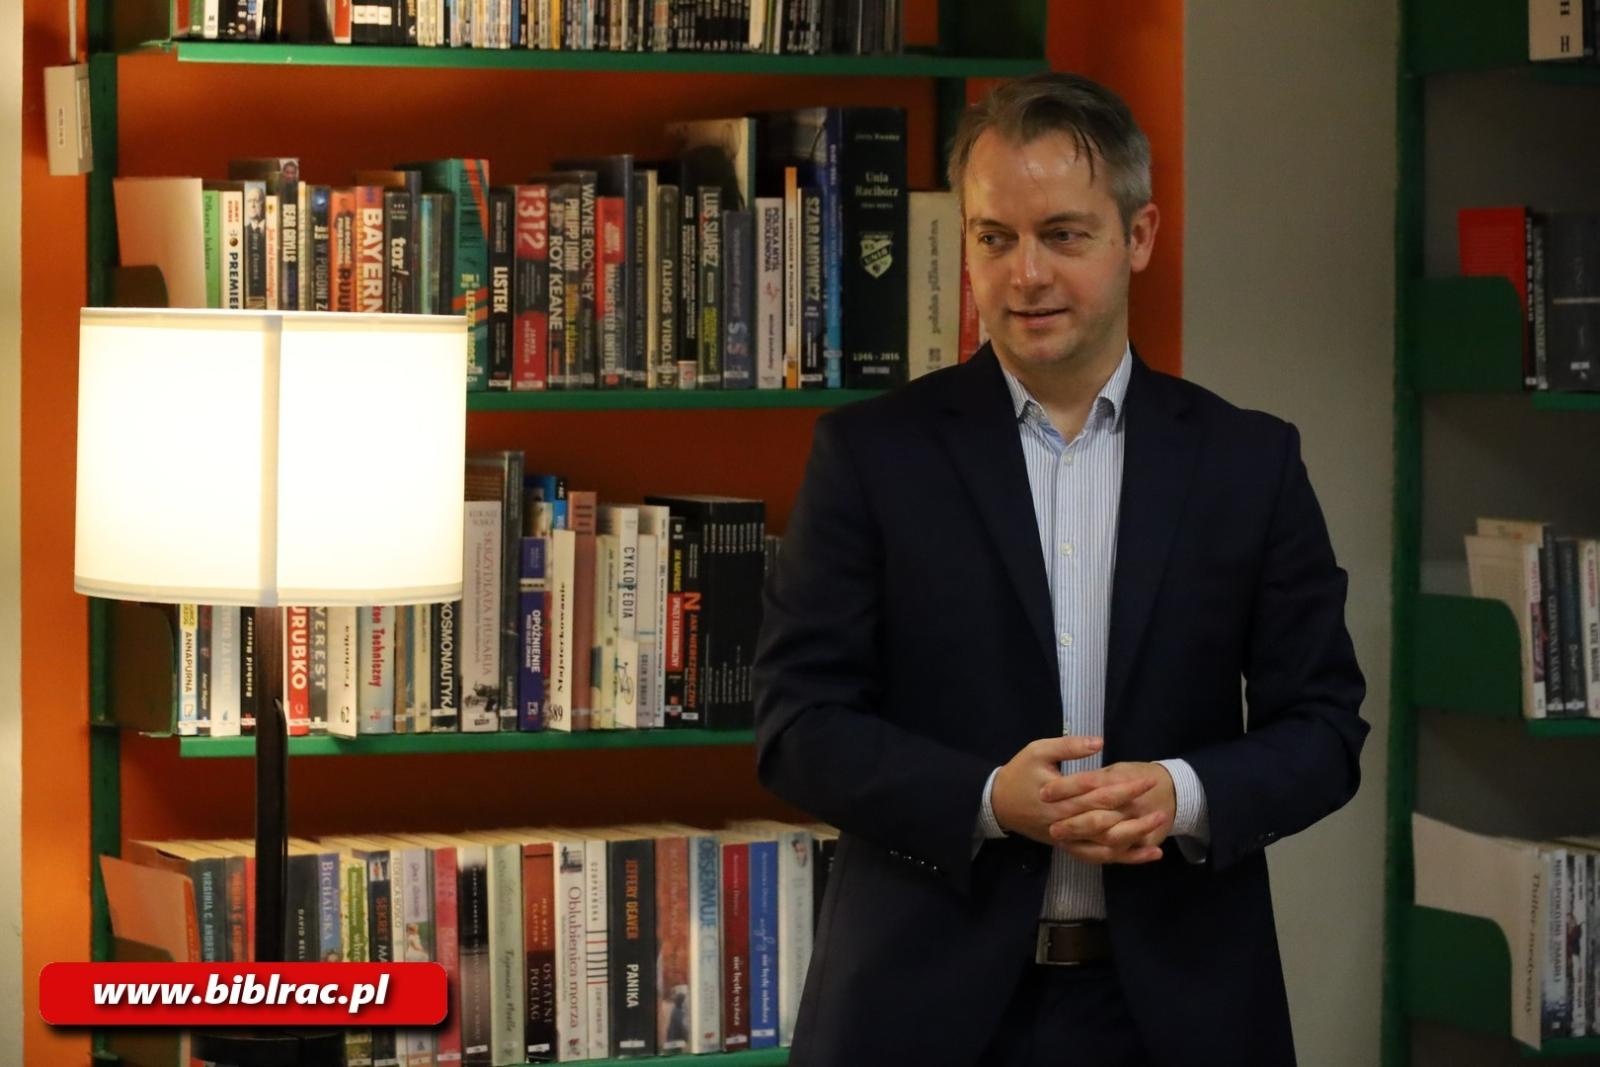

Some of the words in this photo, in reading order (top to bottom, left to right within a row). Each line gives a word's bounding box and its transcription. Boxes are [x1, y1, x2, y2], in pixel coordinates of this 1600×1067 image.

[282, 203, 296, 228] BEAR
[517, 187, 547, 249] 1312
[564, 198, 580, 239] PHILIPP
[581, 183, 594, 234] WAYNE
[702, 192, 719, 219] LUIS
[772, 207, 780, 245] POLSKA
[282, 228, 296, 263] GRYLLS
[362, 207, 383, 312] BAYERN
[390, 236, 409, 276] tor!
[549, 235, 564, 272] ROY
[805, 196, 820, 301] SZARANOWICZ
[338, 268, 351, 312] RUU
[493, 266, 508, 313] LISTEK
[581, 238, 594, 301] ROONEY
[662, 259, 673, 314] SPORTU
[549, 273, 563, 330] KEANE
[604, 263, 616, 331] MANCHESTER
[623, 546, 636, 619] CYKLOPEDIA
[184, 631, 193, 693] ANNAPURNA
[368, 628, 386, 688] Techniczny
[531, 609, 542, 673] OPÓŹNIENIE
[202, 871, 213, 911] VIRGINIA
[321, 861, 334, 940] BICHALSKA
[625, 858, 639, 898] JEFFERY
[297, 908, 305, 937] DAVID
[375, 895, 388, 940] SEKRET
[567, 886, 581, 977] Oblubienica
[625, 901, 639, 940] DEAVER
[626, 963, 639, 1008] PANIKA
[732, 956, 742, 971] nie
[542, 962, 553, 1024] OSTATNI
[568, 981, 580, 1028] morza
